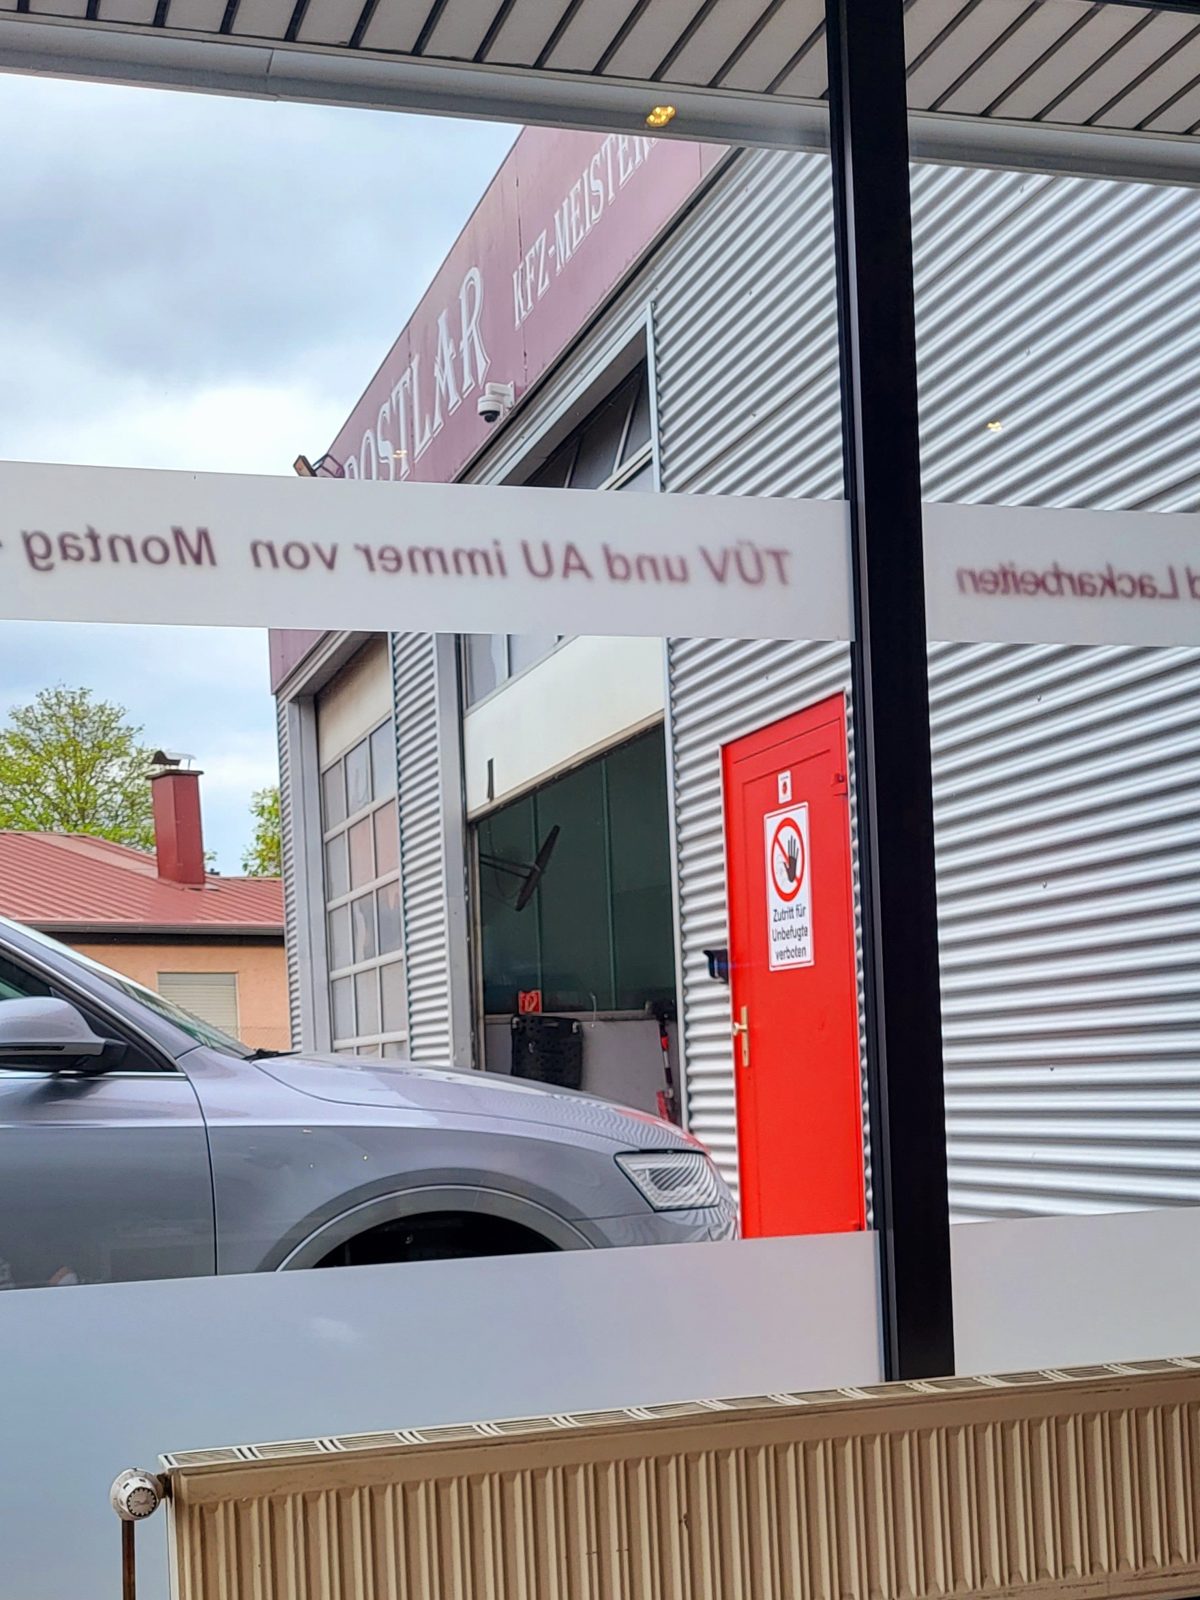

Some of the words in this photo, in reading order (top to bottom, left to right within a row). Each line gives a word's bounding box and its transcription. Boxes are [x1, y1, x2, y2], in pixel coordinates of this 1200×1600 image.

[343, 266, 491, 481] OSTLAR
[773, 906, 795, 922] Zutritt
[795, 903, 807, 919] für
[772, 925, 808, 942] Unbefugte
[775, 946, 807, 961] verboten
